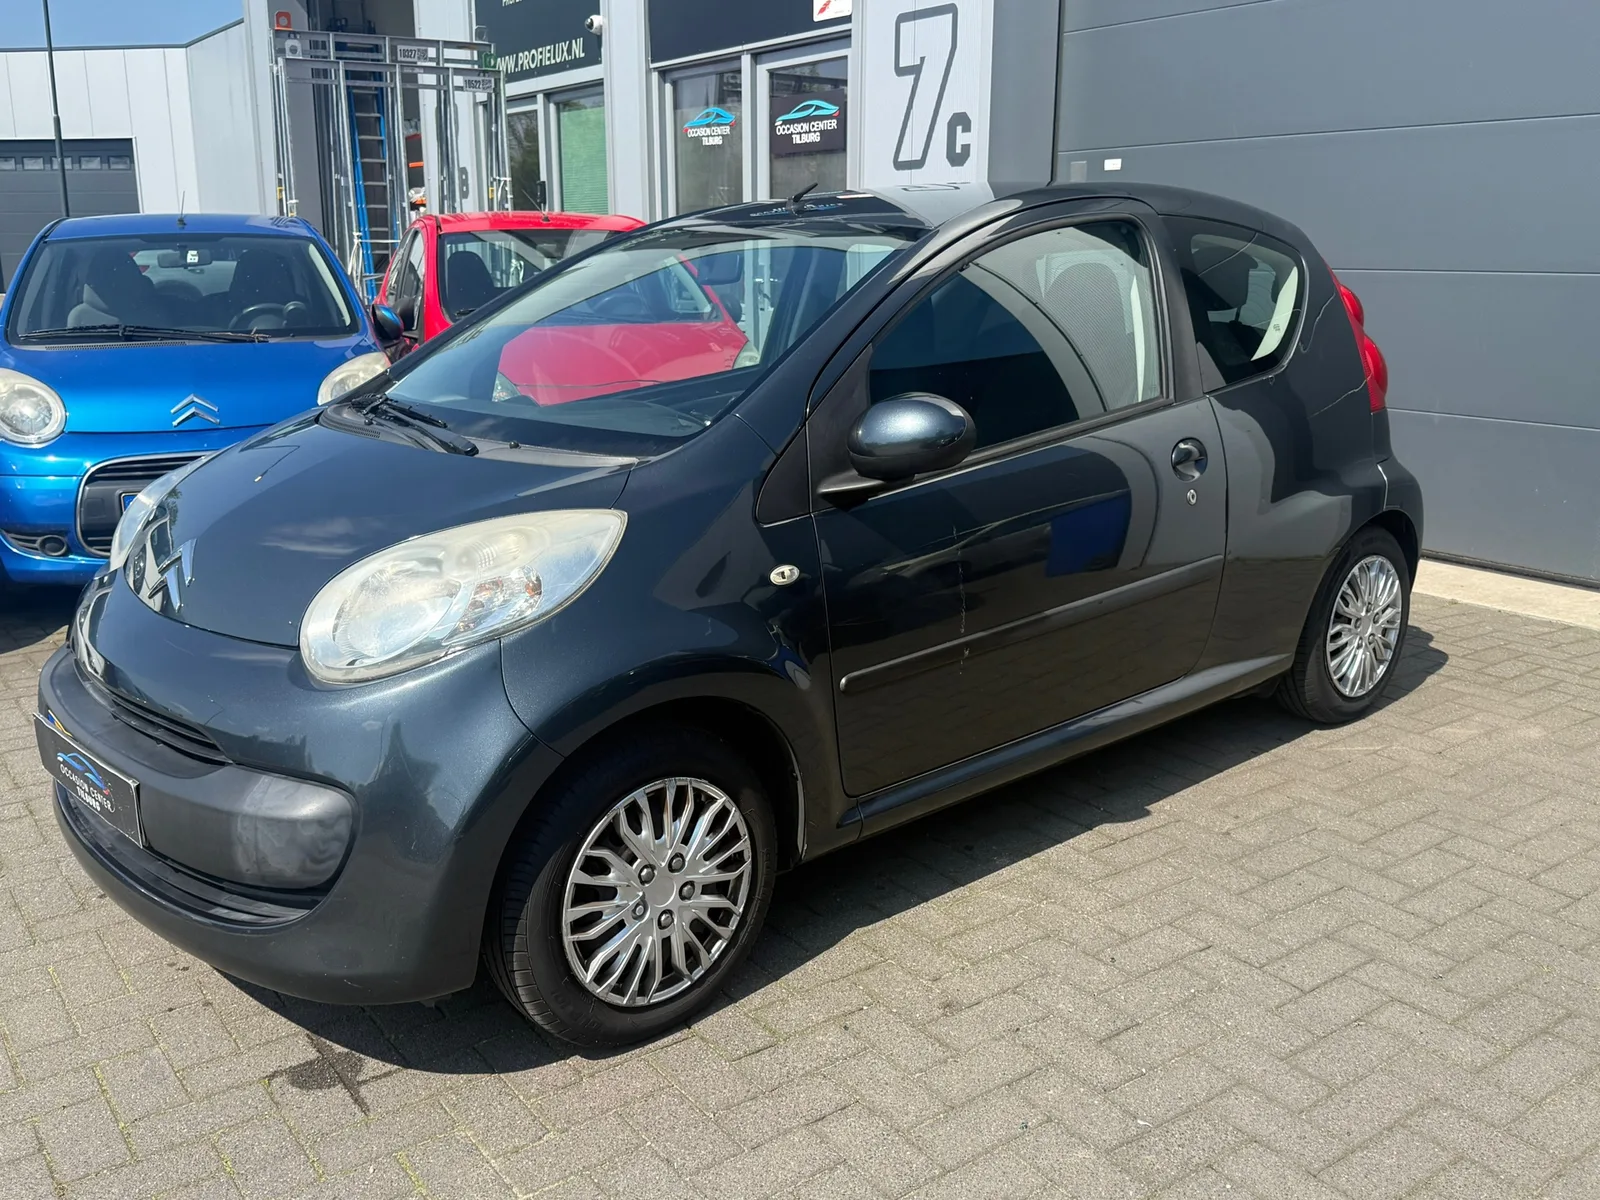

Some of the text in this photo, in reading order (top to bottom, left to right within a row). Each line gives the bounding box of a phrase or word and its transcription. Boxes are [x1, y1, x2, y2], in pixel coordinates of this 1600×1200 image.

[496, 37, 585, 75] WW.PROFIELUX.NL
[687, 125, 731, 138] OCCASION CENTER
[776, 119, 837, 135] OCCASION CENTER
[702, 136, 723, 146] TILBURG
[791, 132, 821, 144] TILBURG
[60, 763, 90, 793] OCCASION
